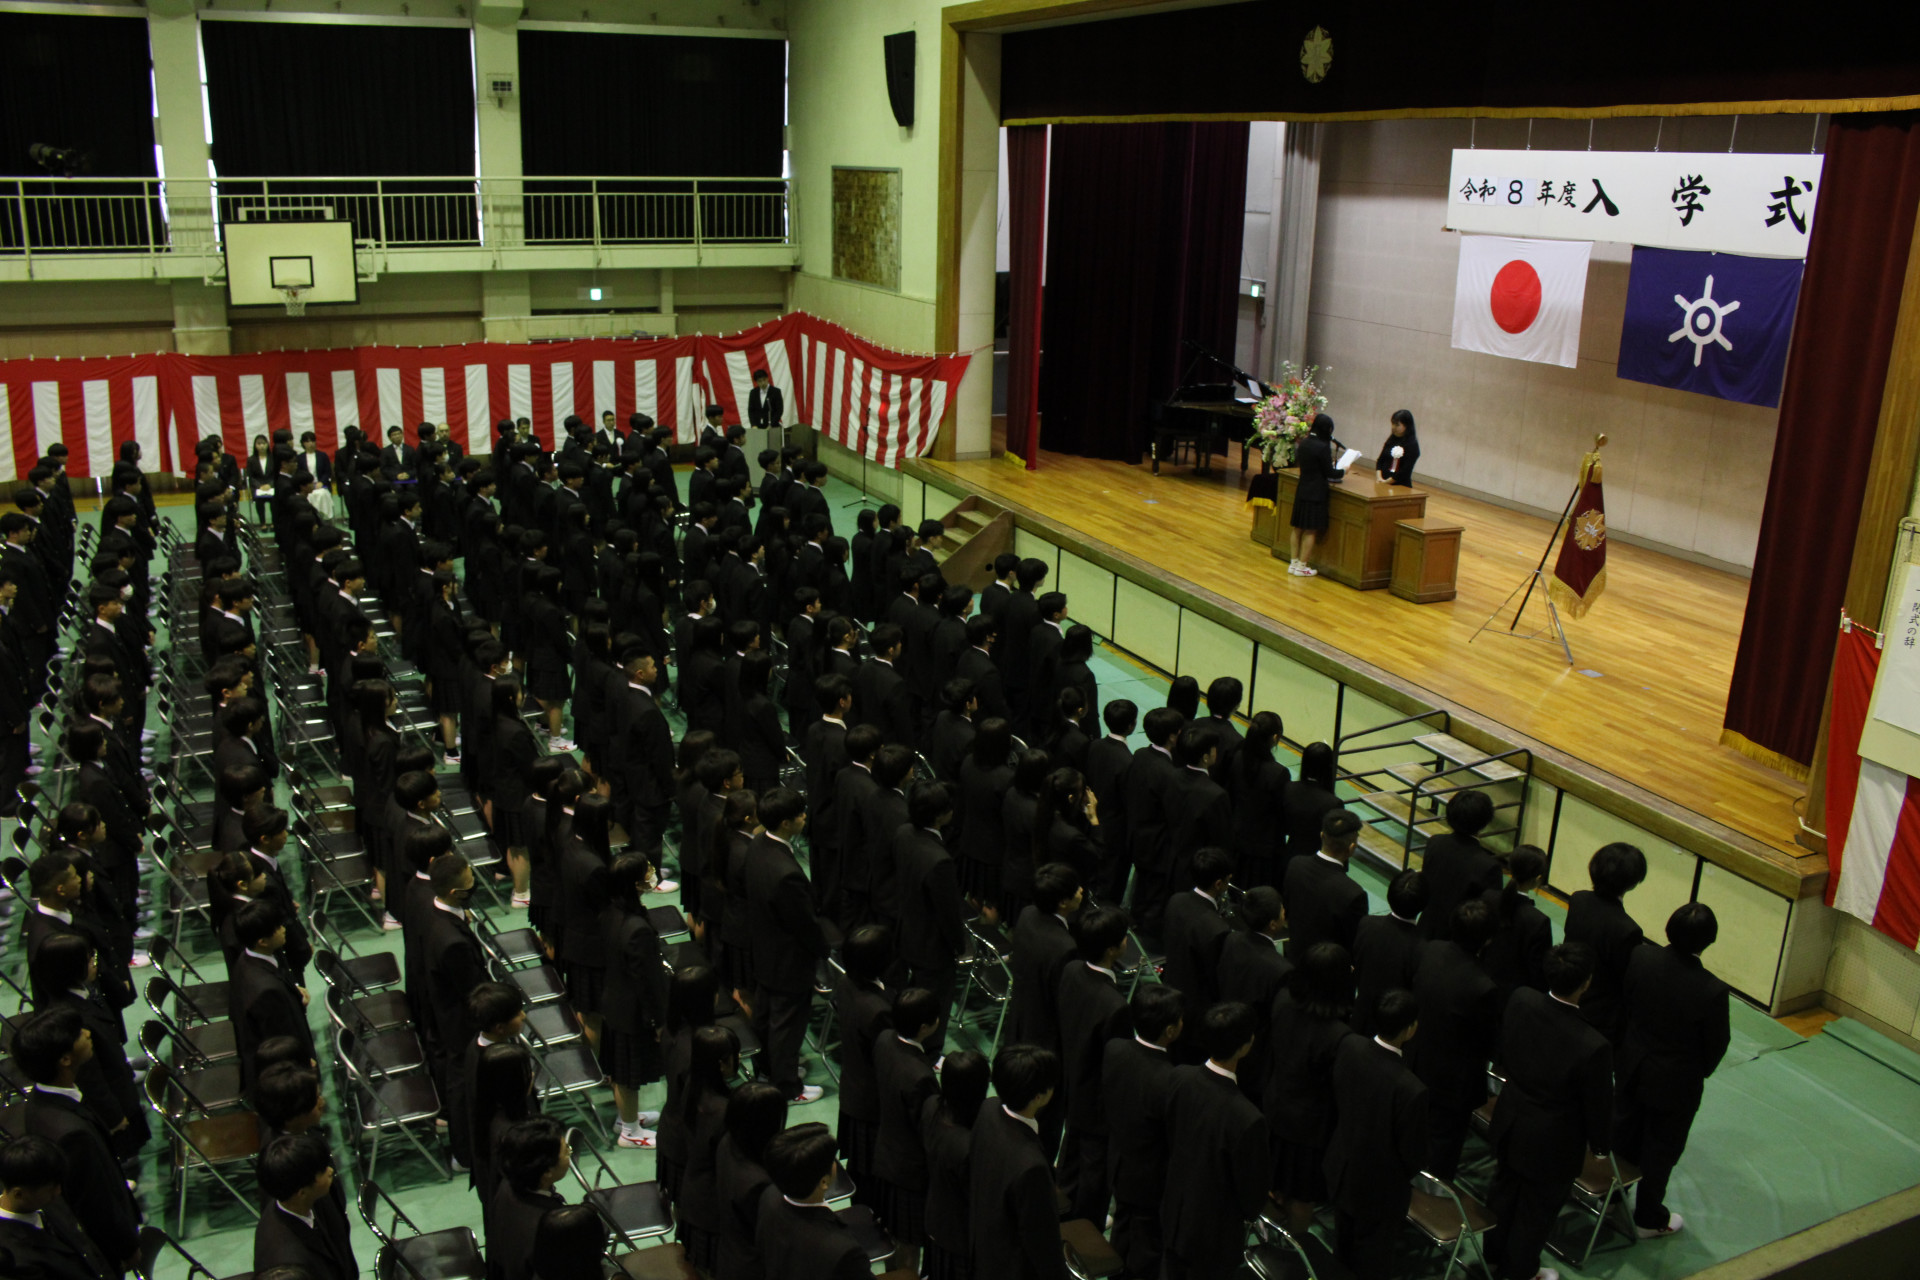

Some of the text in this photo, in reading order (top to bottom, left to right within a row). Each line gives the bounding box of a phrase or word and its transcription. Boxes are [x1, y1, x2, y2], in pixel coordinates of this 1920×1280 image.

[1459, 174, 1813, 234] 令和8年度 入学式
